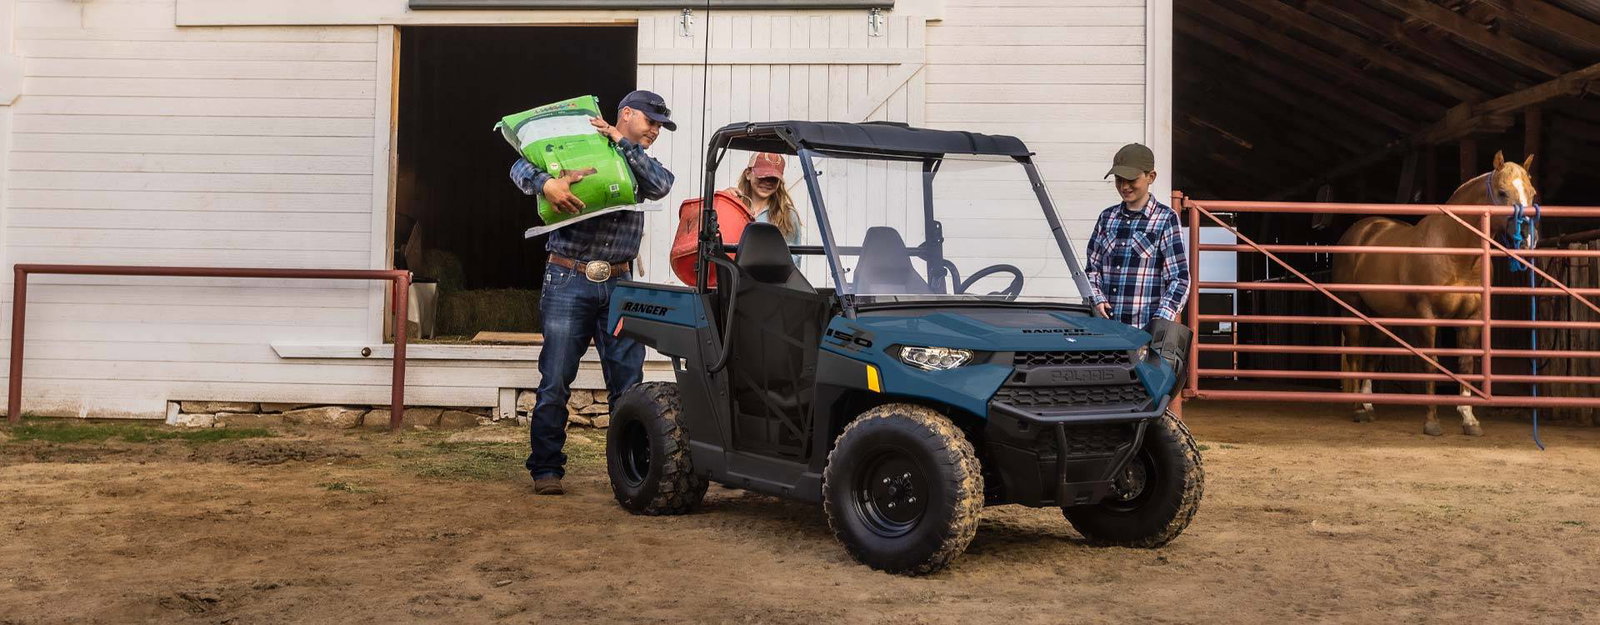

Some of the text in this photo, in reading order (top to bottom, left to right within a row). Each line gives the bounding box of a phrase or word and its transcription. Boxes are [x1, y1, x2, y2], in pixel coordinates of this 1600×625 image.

[624, 301, 668, 316] RANGER
[826, 328, 873, 348] 150
[1050, 369, 1115, 382] POLARIS
